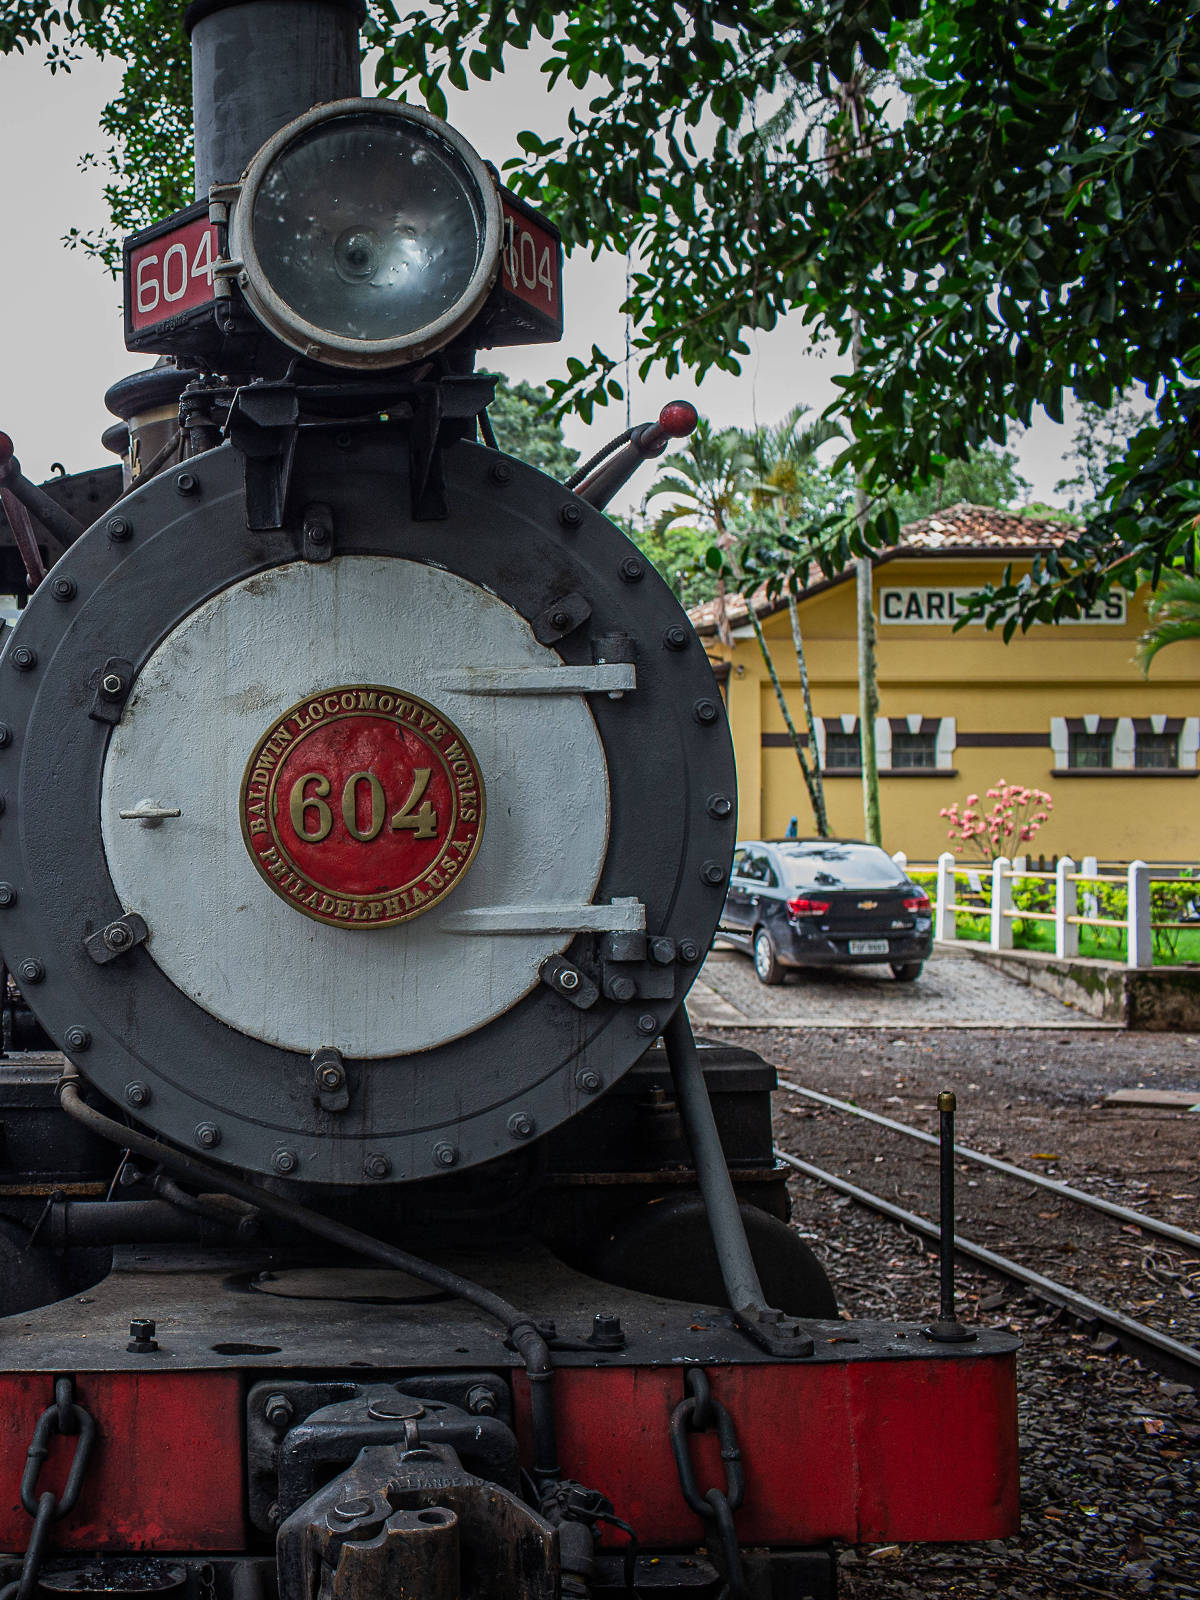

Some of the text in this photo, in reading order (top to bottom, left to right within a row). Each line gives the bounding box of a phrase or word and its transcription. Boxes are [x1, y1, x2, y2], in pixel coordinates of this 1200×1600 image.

[136, 230, 215, 313] 604
[249, 691, 477, 836] BALDWIN LOCOMOTIVE WORKS
[289, 767, 438, 842] 604
